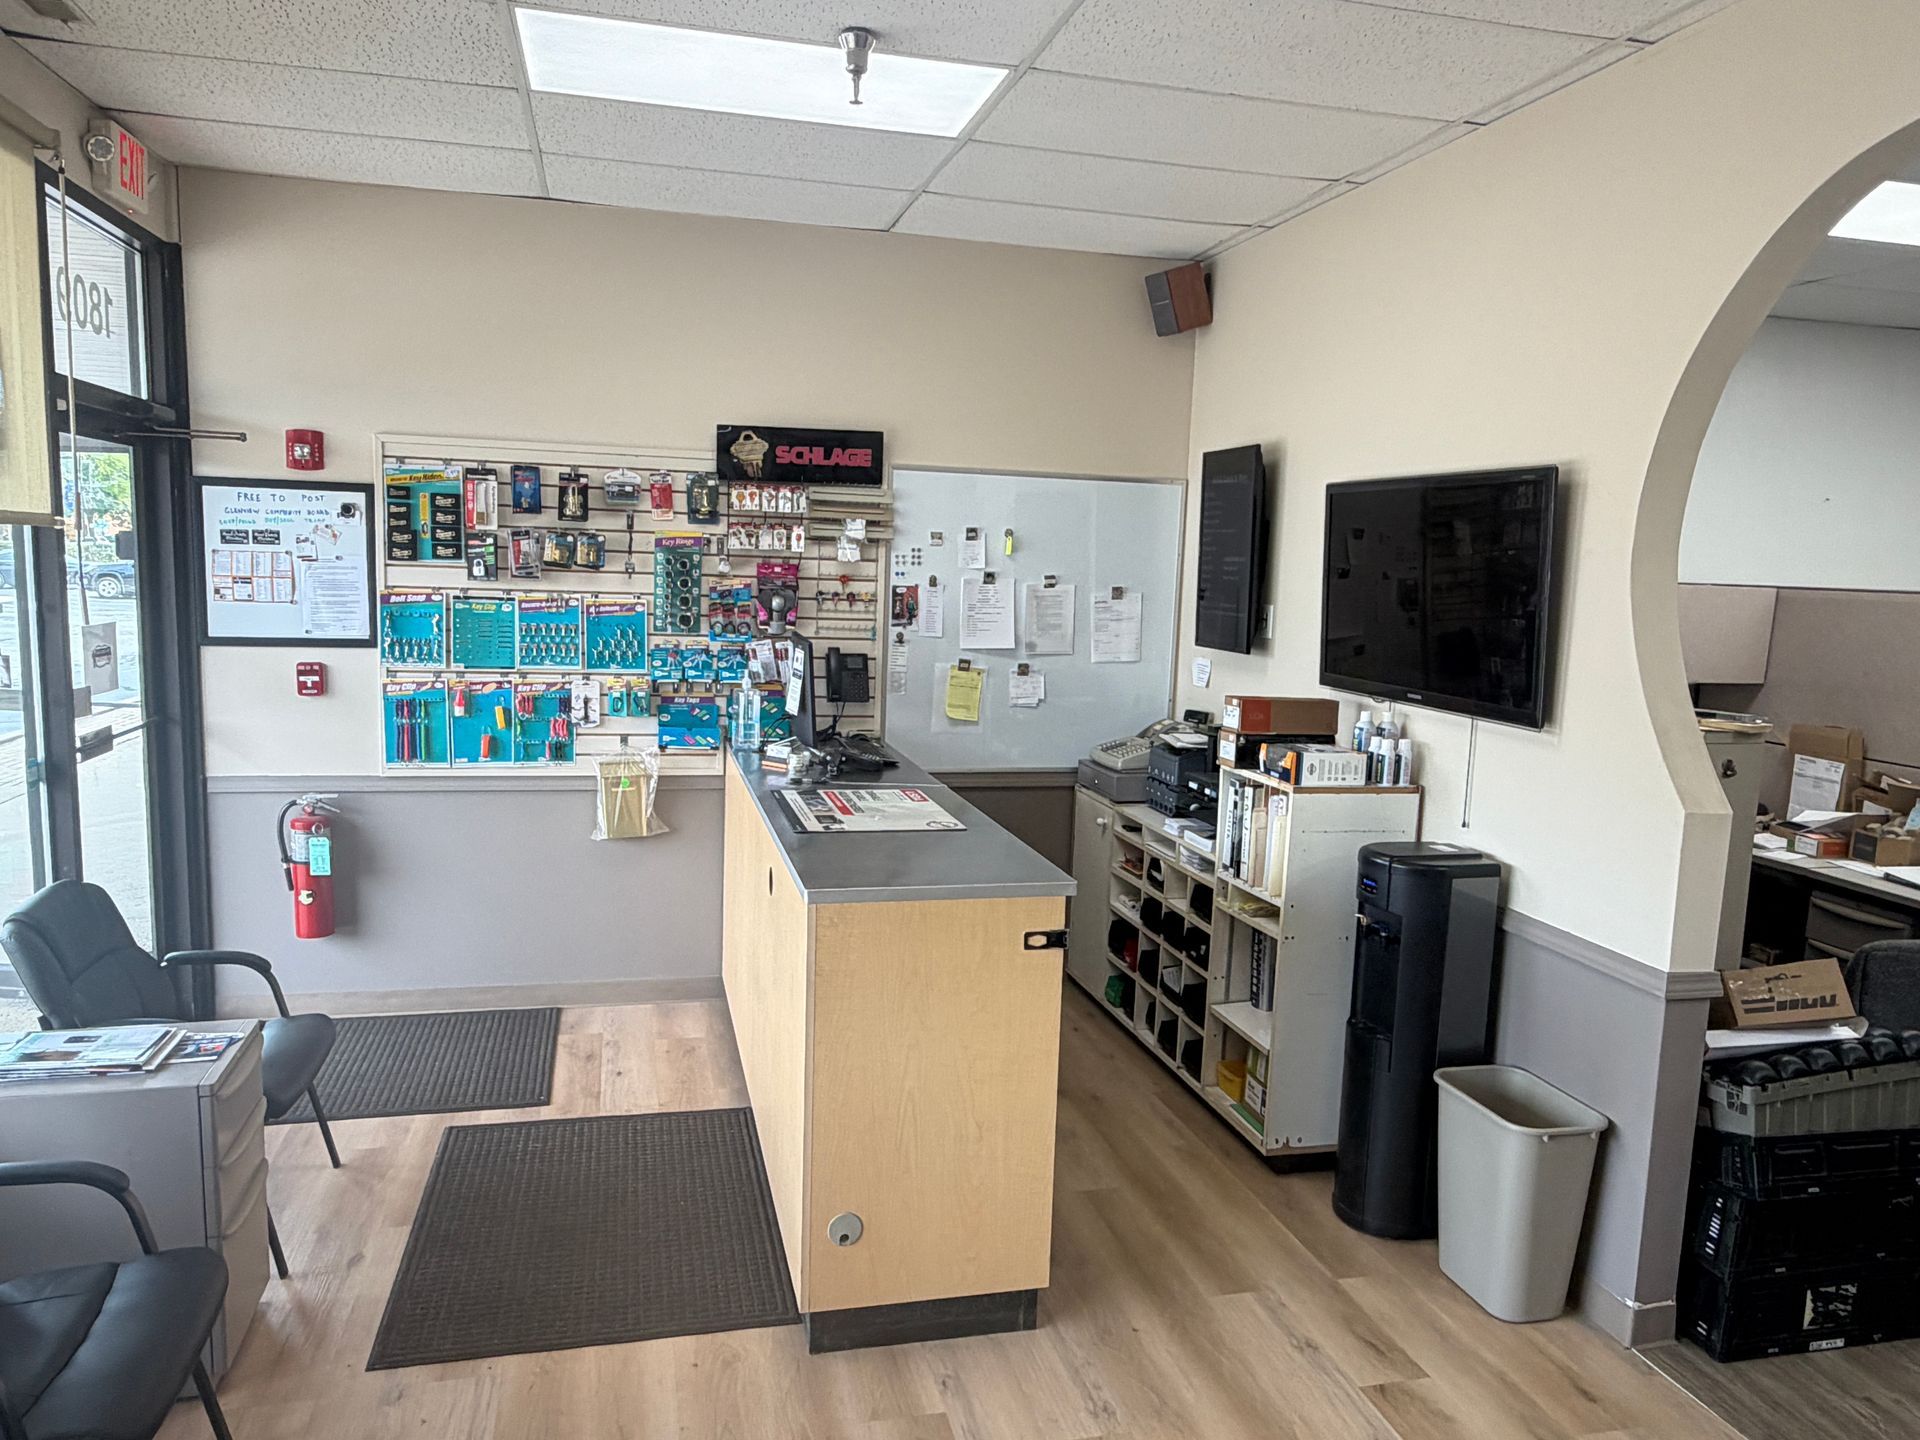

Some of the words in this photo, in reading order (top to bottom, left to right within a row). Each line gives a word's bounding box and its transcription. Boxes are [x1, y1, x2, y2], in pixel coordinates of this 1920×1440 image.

[119, 129, 145, 200] EXIT
[775, 445, 872, 467] SCHLAGE
[237, 491, 261, 502] FREE
[270, 493, 286, 502] TO
[301, 494, 325, 502] POST
[661, 538, 674, 547] Key
[675, 537, 694, 546] Rings
[471, 603, 483, 611] Key
[386, 684, 401, 692] Key
[401, 683, 416, 691] Clip
[517, 684, 531, 692] Key
[531, 683, 547, 691] Clip
[674, 696, 686, 704] Key
[686, 696, 700, 704] Tags
